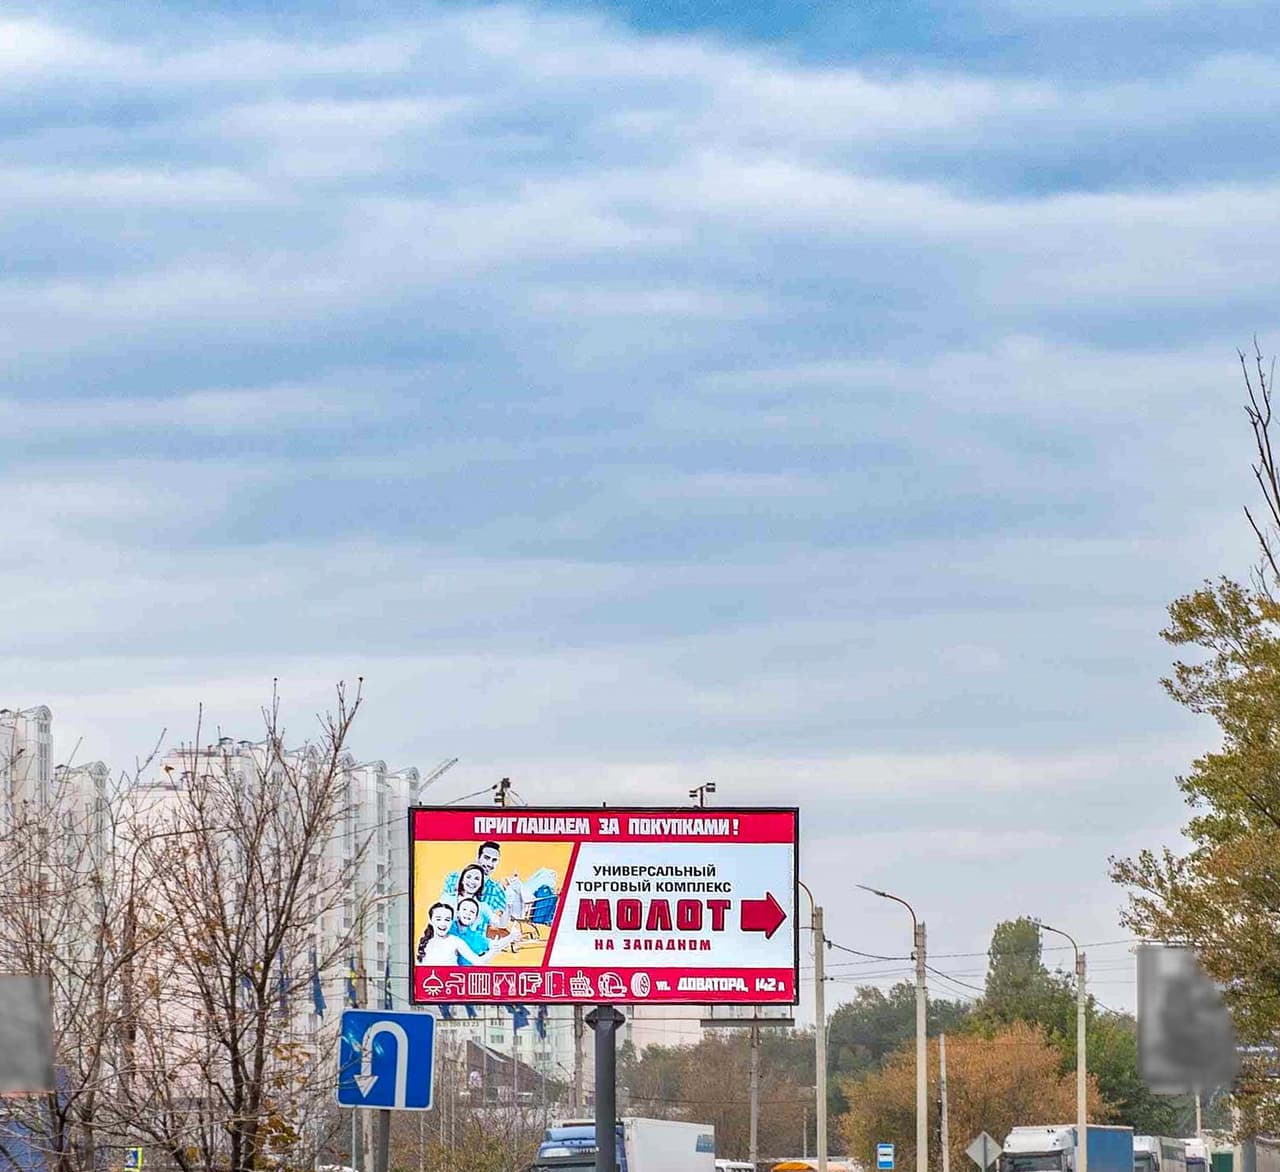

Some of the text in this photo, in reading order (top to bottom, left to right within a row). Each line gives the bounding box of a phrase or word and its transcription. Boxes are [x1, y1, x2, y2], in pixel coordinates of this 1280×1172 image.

[474, 817, 590, 834] ПРИГЛАШАЕМ
[599, 818, 619, 834] ЗА
[593, 864, 716, 877] УНИВЕРСАЛЬНЫЙ
[576, 880, 732, 893] ТОРГОВЫЙ КОМПЛЕКС
[576, 898, 732, 932] МОЛОТ
[595, 939, 712, 951] НА ЗАПАДНОМ
[677, 977, 749, 992] ДОВАТОРА,
